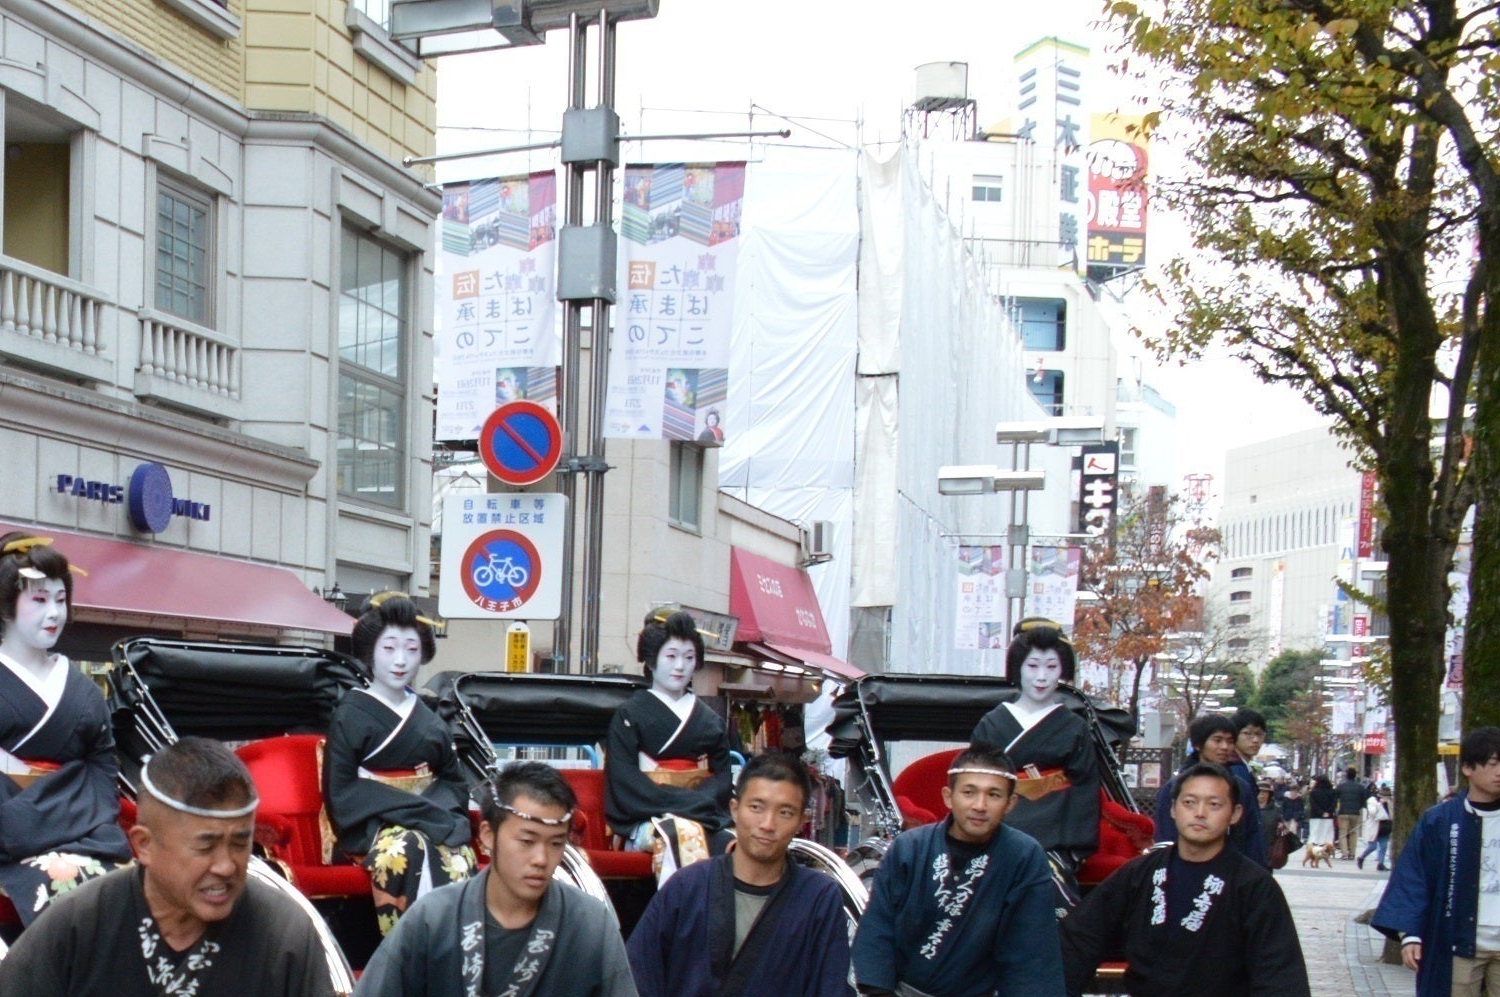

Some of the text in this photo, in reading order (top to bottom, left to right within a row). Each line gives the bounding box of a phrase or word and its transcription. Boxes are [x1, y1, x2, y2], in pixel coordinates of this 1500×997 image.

[57, 474, 211, 521] PARIS MIKI
[463, 499, 545, 510] 自転車等
[463, 513, 545, 524] 放置禁止区域
[475, 595, 523, 612] 八王子市
